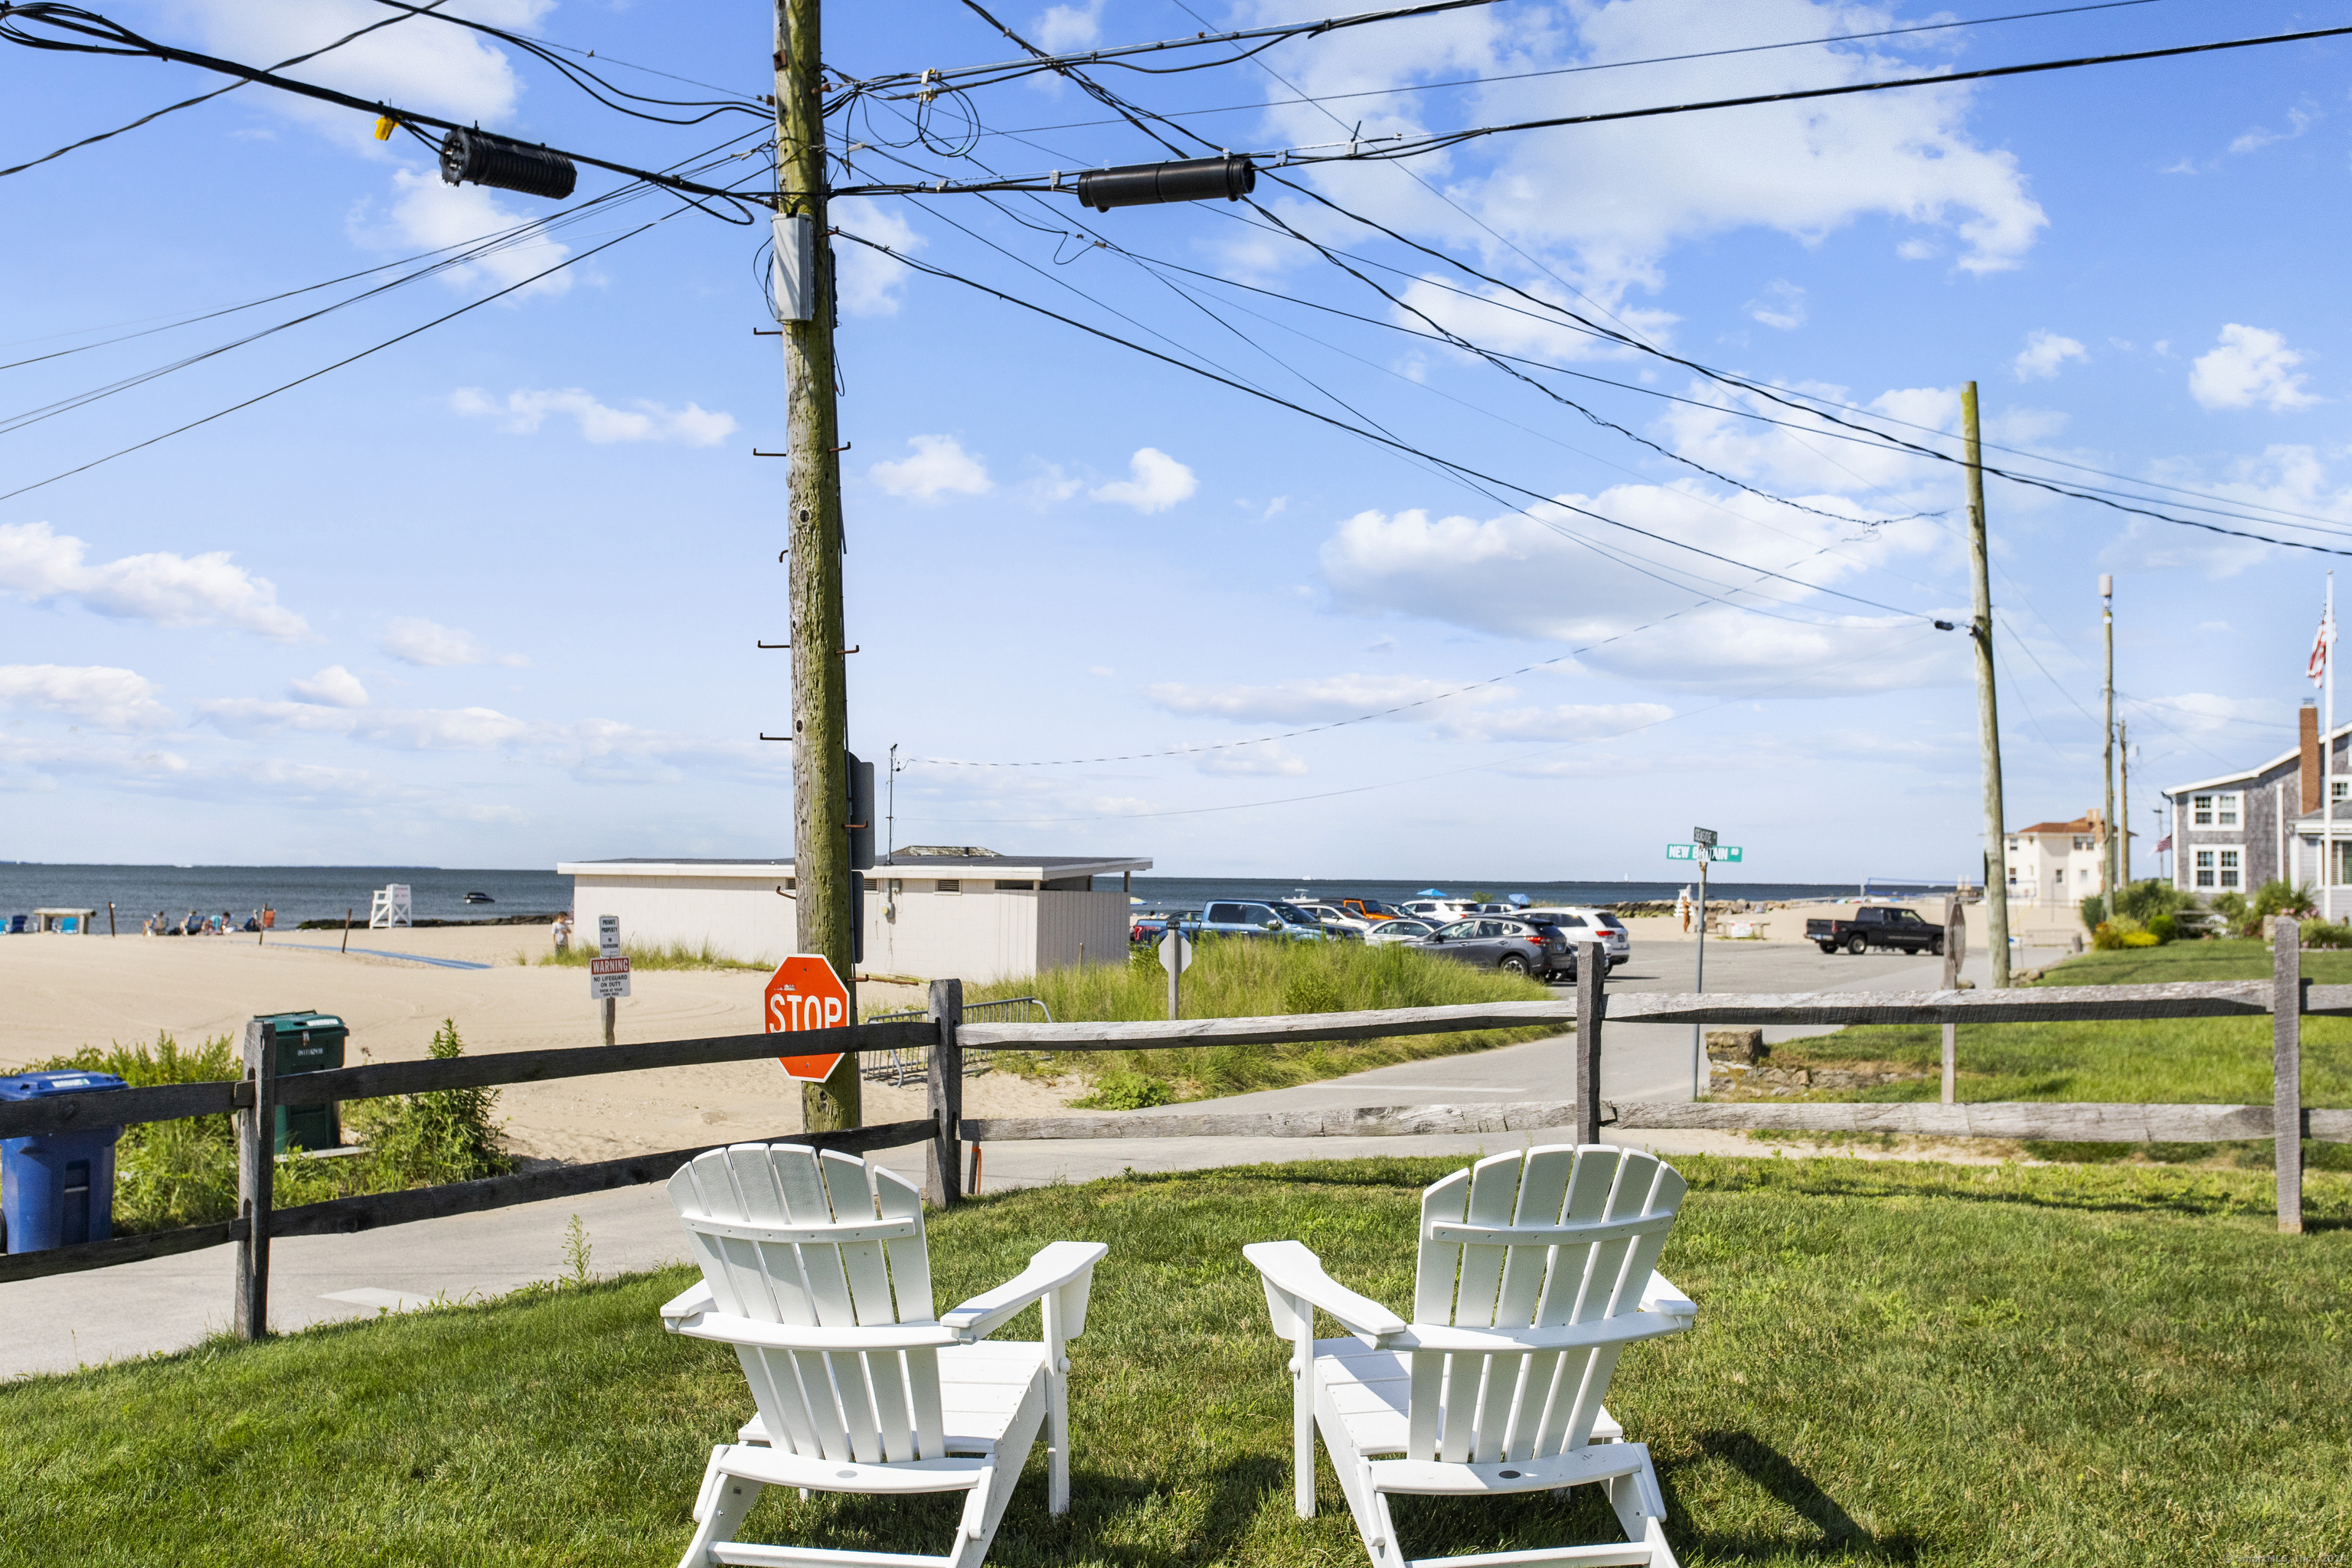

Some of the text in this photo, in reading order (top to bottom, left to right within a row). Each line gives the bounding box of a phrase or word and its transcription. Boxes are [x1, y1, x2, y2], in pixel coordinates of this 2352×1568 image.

[1694, 828, 1712, 844] SEASIDE
[1669, 845, 1740, 861] NEW BRITAIN RD
[593, 959, 628, 973] WARNING
[769, 994, 842, 1034] STOP
